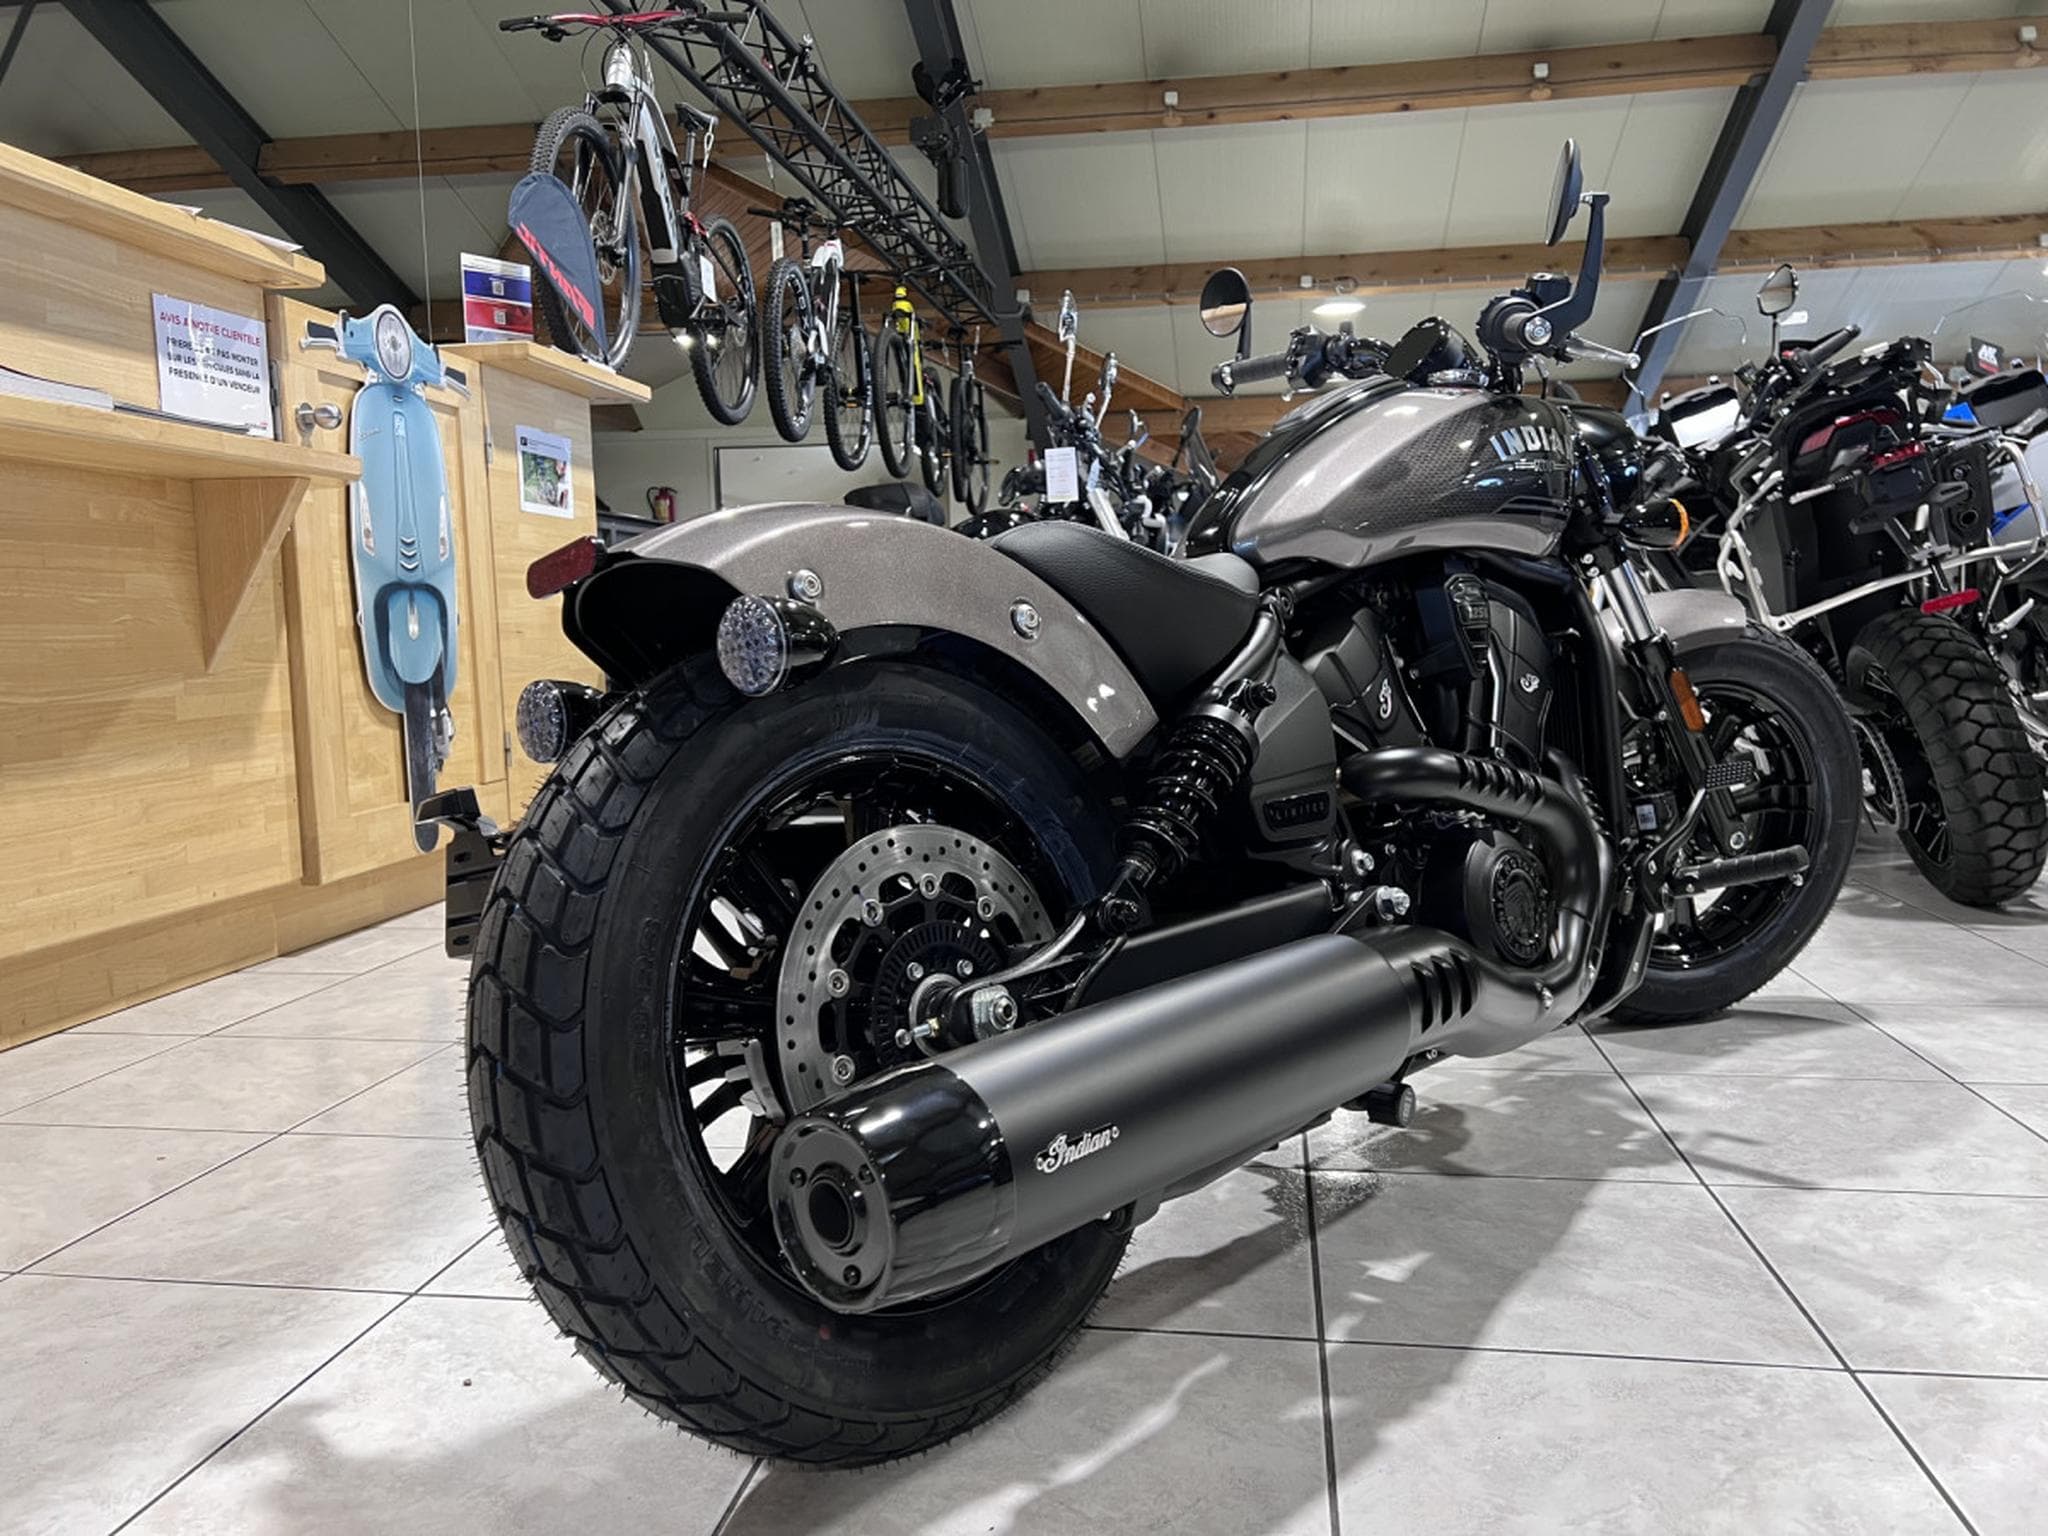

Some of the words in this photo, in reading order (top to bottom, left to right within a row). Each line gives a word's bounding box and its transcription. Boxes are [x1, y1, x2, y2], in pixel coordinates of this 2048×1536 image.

[160, 311, 180, 326] AVIS
[168, 366, 209, 383] PRESENE
[1041, 1129, 1113, 1173] Indian
